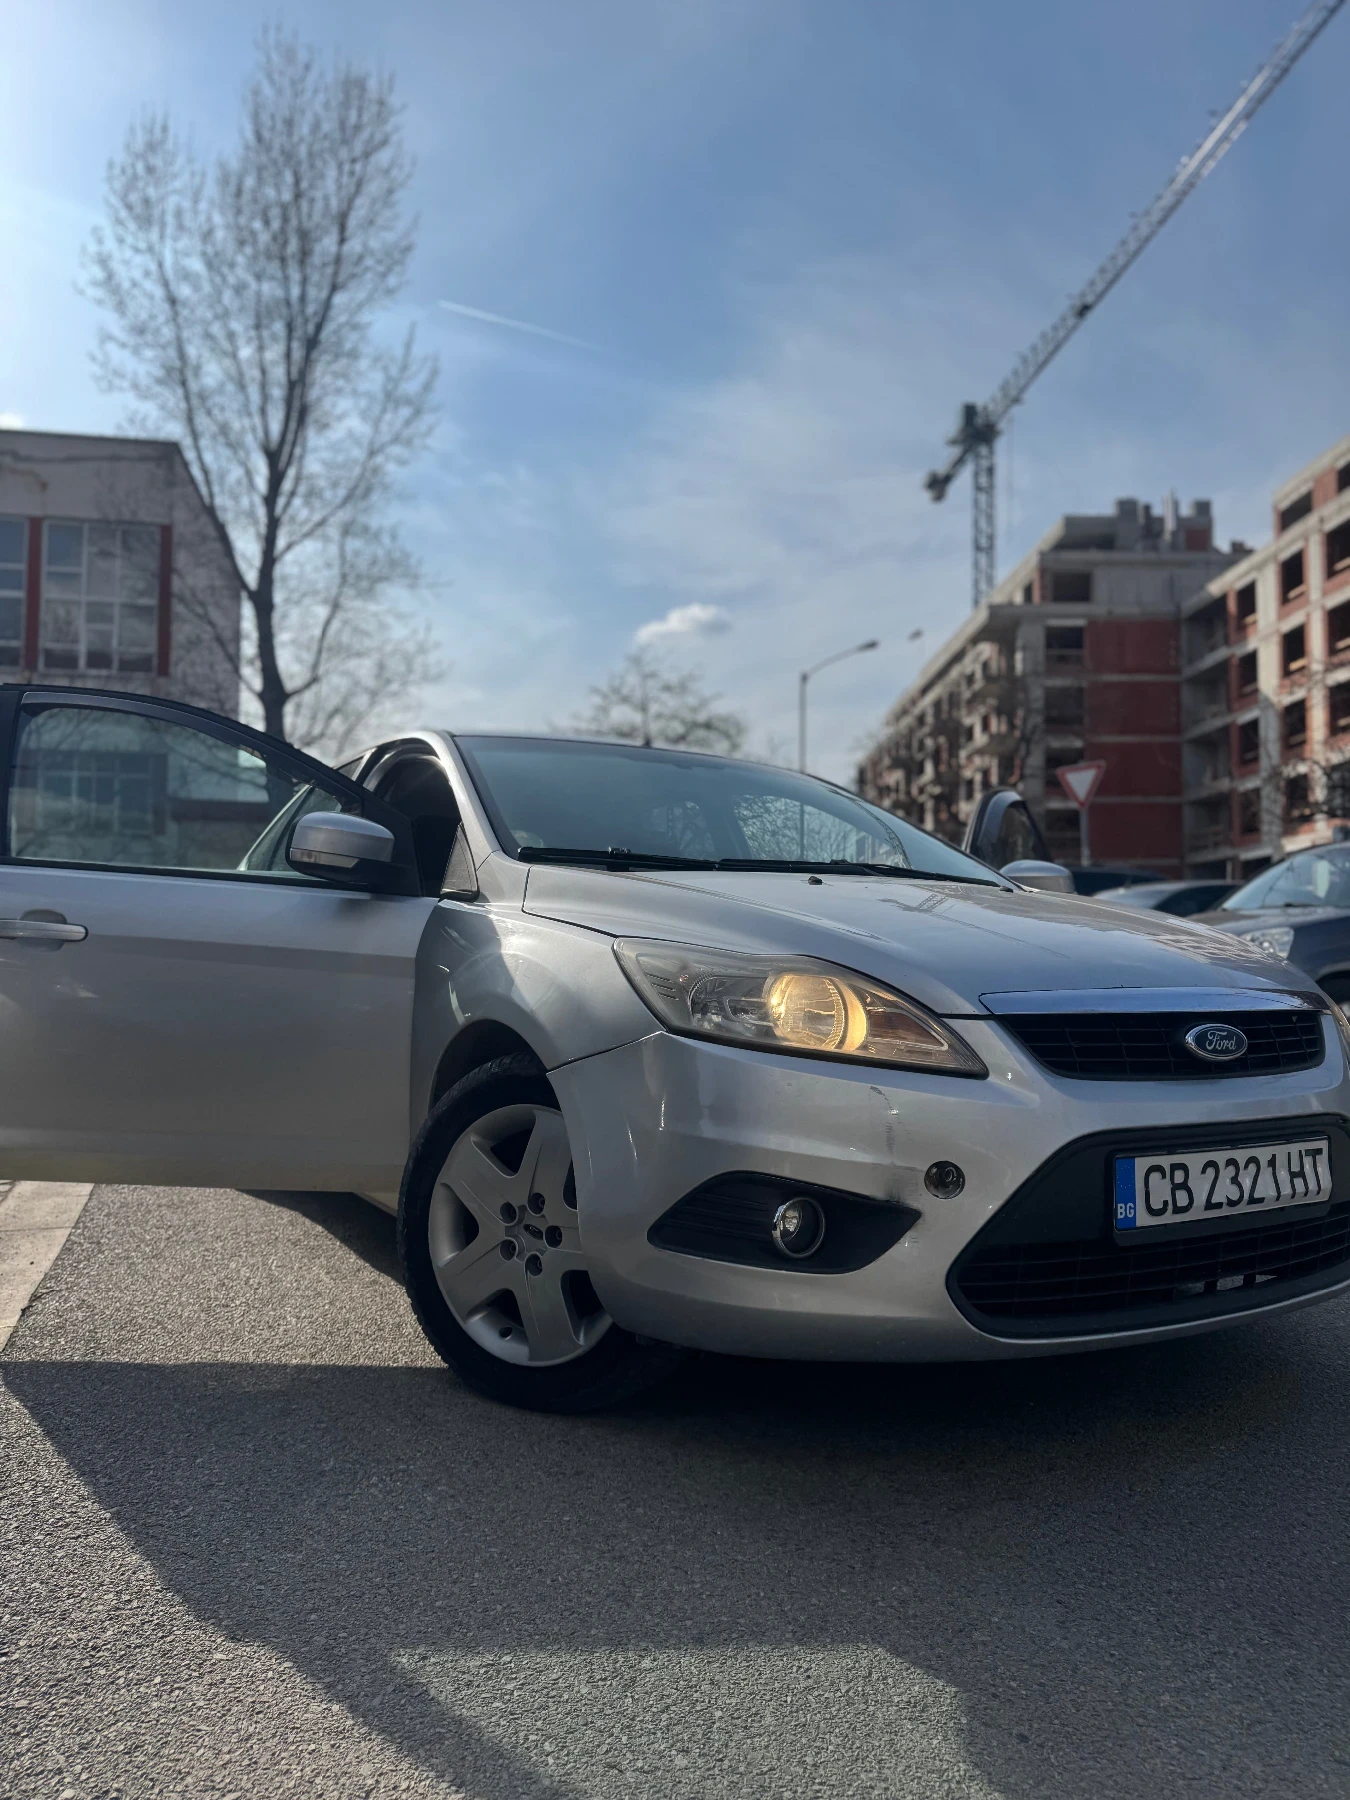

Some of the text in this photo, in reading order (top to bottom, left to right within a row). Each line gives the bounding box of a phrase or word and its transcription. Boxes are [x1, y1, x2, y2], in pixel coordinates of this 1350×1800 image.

[1206, 1030, 1237, 1050] Ford
[1144, 1162, 1195, 1217] CB
[1117, 1202, 1135, 1219] BG
